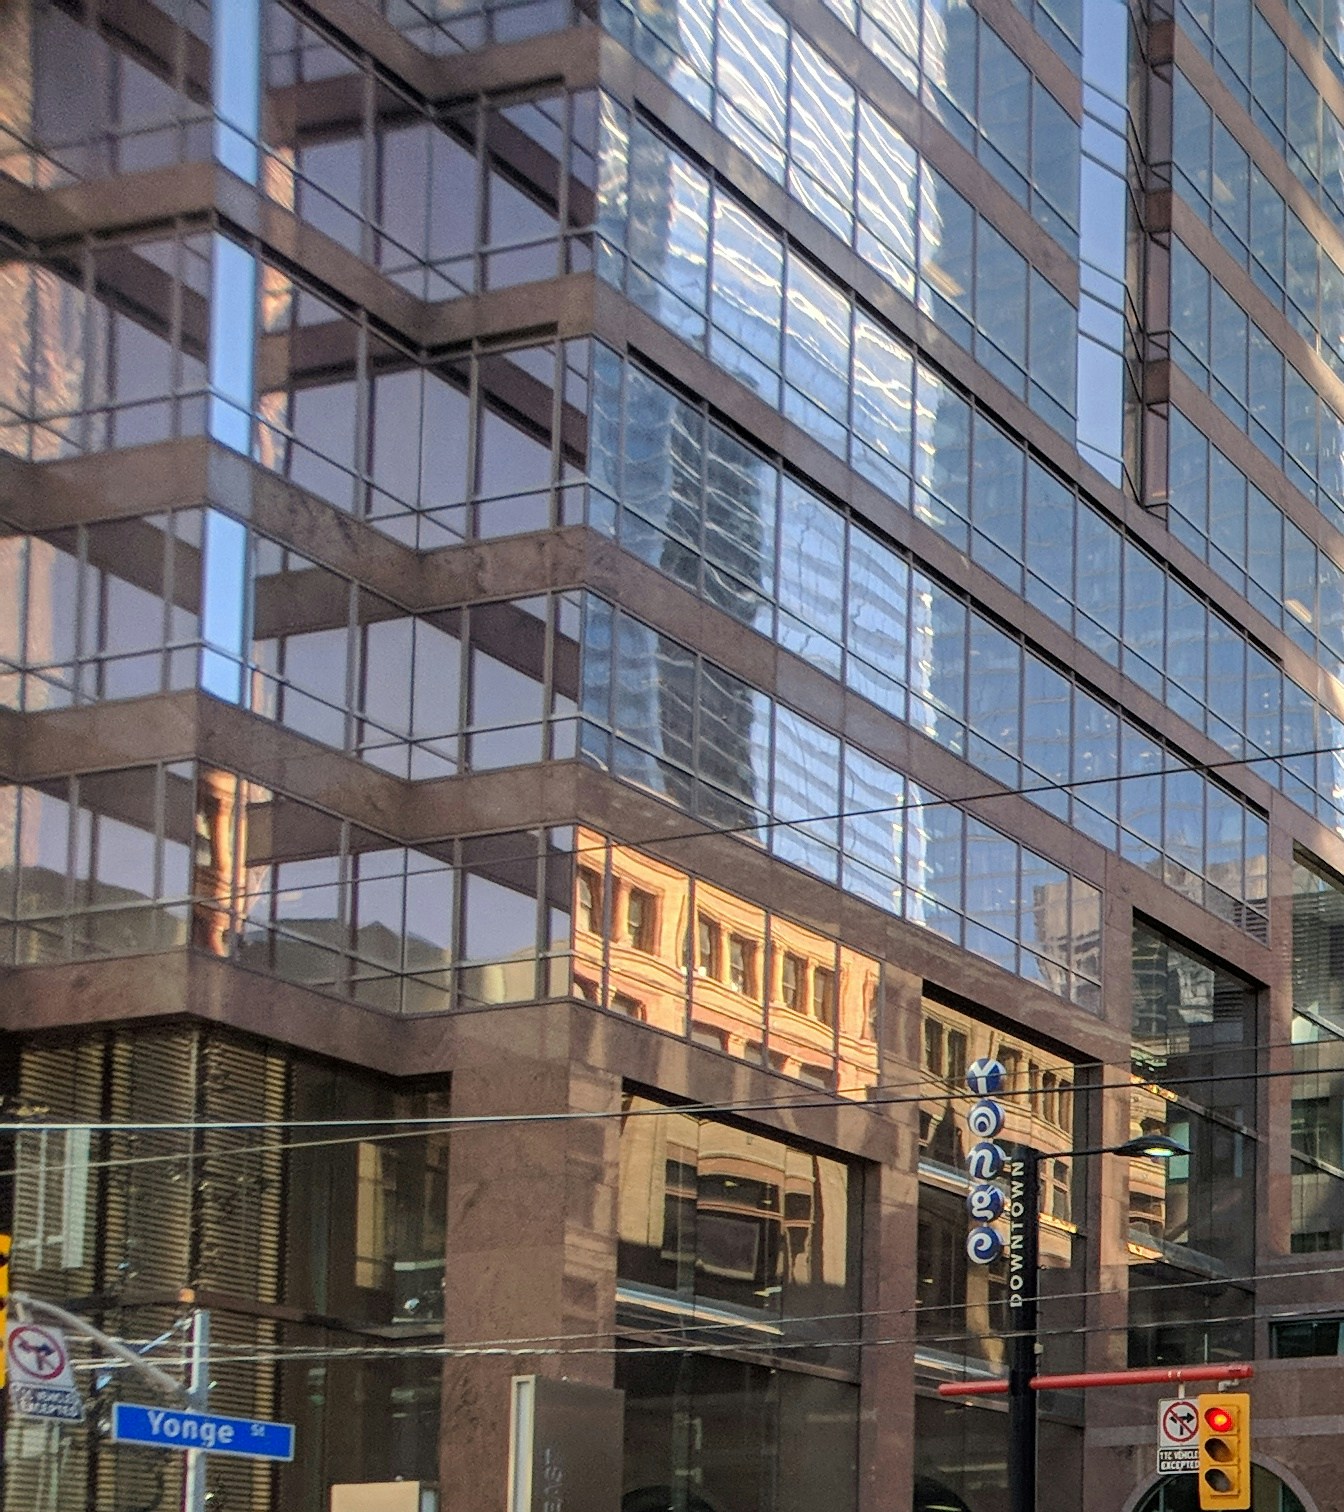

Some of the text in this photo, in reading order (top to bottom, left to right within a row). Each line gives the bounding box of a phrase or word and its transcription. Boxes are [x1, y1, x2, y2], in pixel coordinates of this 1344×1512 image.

[966, 1058, 1007, 1265] Yonge
[1010, 1161, 1025, 1308] DOWNTOWN
[147, 1411, 265, 1448] Yonge St
